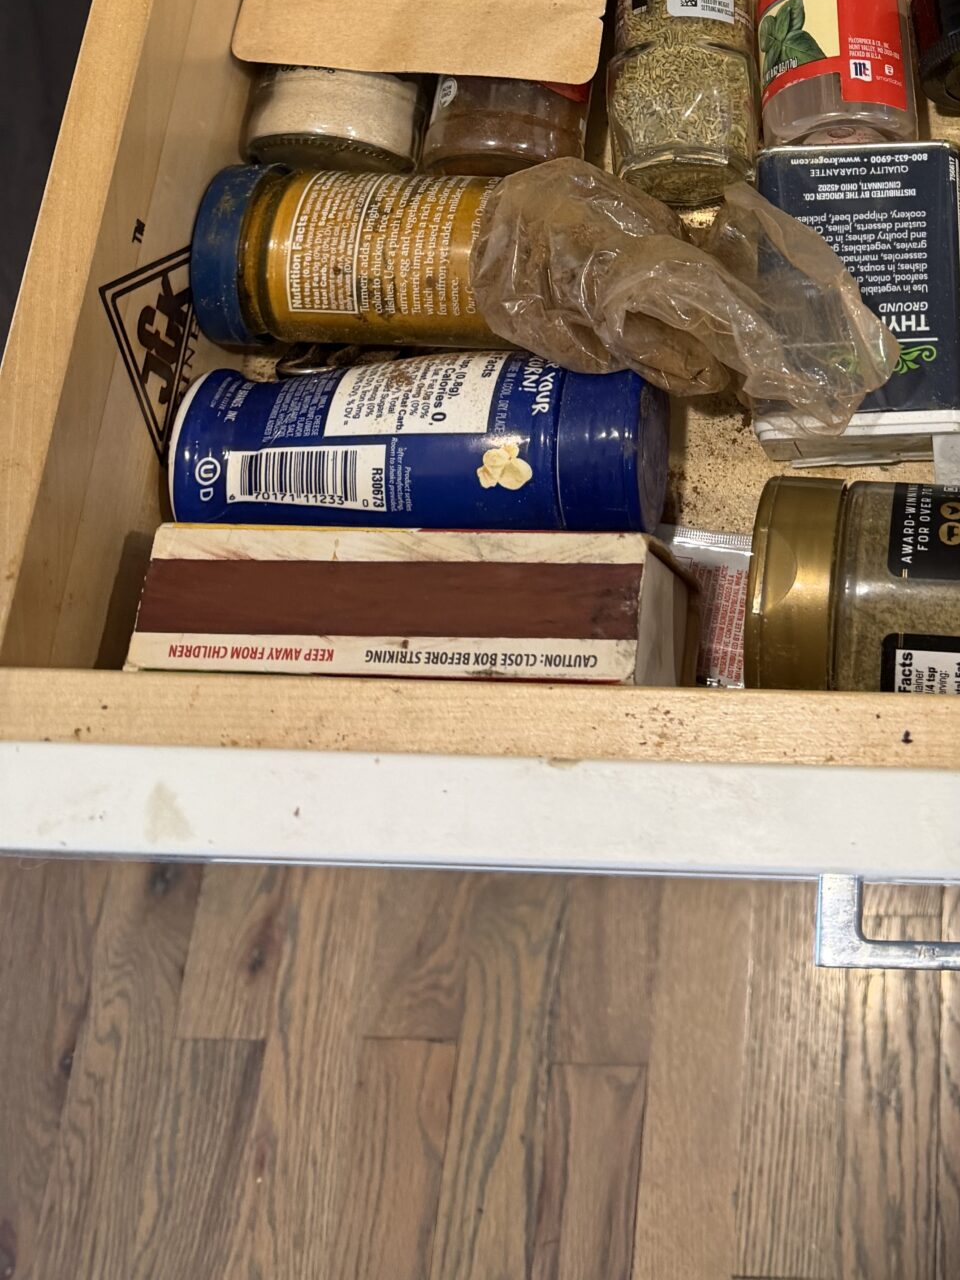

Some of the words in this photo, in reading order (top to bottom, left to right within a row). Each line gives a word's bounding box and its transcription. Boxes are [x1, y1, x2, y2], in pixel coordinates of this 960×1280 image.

[791, 156, 860, 165] www.kroger.com
[871, 154, 928, 163] 800-632-6900
[810, 167, 867, 177] GUARANTEE
[870, 166, 908, 174] QUALITY
[817, 192, 844, 200] KROGER
[871, 189, 916, 197] DISTRIBUTED
[296, 215, 308, 250] Facts
[291, 255, 302, 309] Nutrition
[903, 284, 910, 292] in
[913, 284, 928, 292] Use
[860, 285, 901, 295] vegetable
[879, 302, 928, 311] GROUND
[433, 367, 456, 409] Calories
[531, 372, 554, 415] YOUR
[372, 468, 384, 508] R30673
[168, 643, 227, 658] CHILDREN
[230, 646, 264, 660] FROM
[267, 648, 301, 660] AWAY
[305, 648, 334, 662] KEEP
[365, 650, 421, 664] STRIKING
[424, 652, 469, 665] BEFORE
[473, 652, 496, 665] BOX
[500, 653, 536, 667] CLOSE
[540, 654, 598, 668] CAUTION:
[899, 652, 913, 693] Facts
